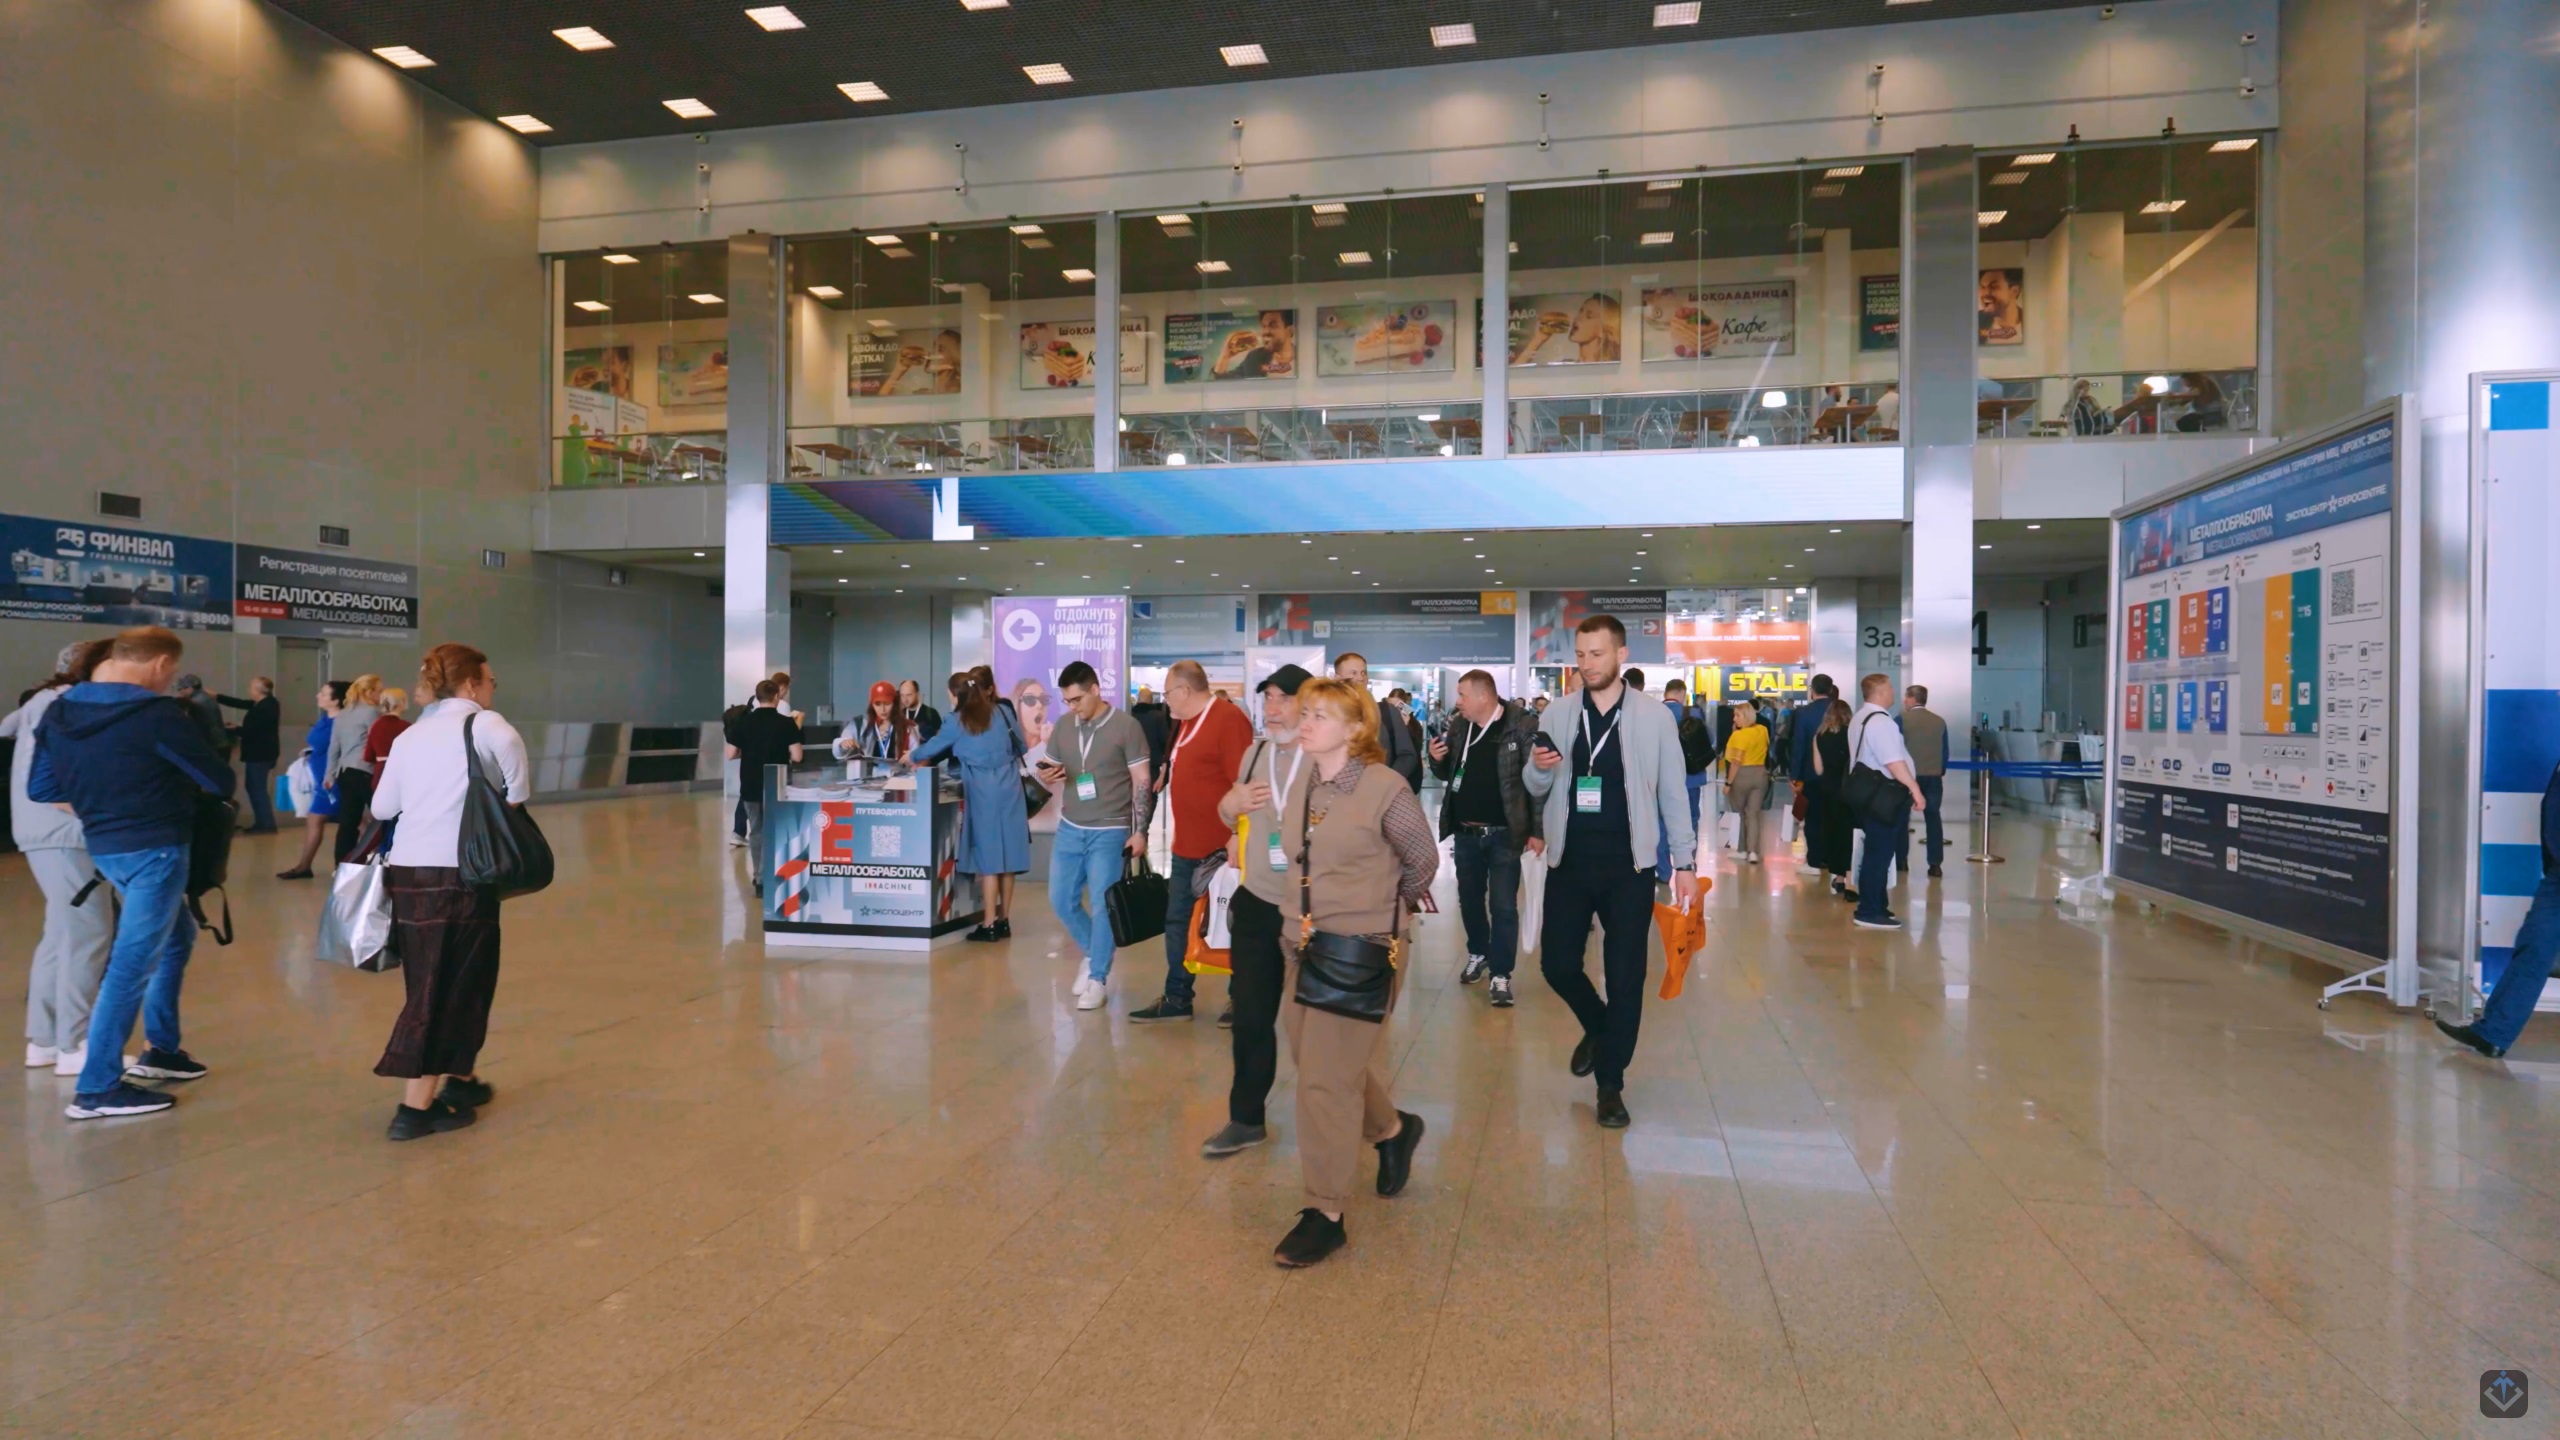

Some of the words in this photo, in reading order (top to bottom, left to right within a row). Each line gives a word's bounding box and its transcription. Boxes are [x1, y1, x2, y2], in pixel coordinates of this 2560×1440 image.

[1688, 289, 1788, 302] ШОКОЛАДНИЦА
[1721, 314, 1767, 342] Кафе
[851, 354, 885, 365] ДЕТКА!
[2337, 484, 2387, 508] EXPOCENTRE
[2190, 504, 2273, 542] МЕТАЛЛООБРАБОТКА
[90, 531, 174, 558] ФИНВАЛ
[2314, 542, 2321, 561] 3
[260, 556, 336, 576] Регистрация
[339, 567, 407, 583] посетителей
[2224, 564, 2230, 581] 2
[0, 600, 44, 609] АВИГАТОР
[244, 583, 408, 612] МЕТАЛЛООБРАБОТКА
[0, 609, 82, 621] РОМЫШЛЕННОСТИ
[1054, 608, 1117, 622] ОТДОХНУТЬ
[1048, 623, 1056, 636] И
[1059, 623, 1117, 636] ПОЛУЧИТЬ
[1863, 626, 1902, 648] За
[1972, 610, 1994, 666] 4
[855, 807, 917, 816] ПУТЕВОДИТЕЛЬ
[812, 864, 926, 878] МЕТАЛЛООБРАБОТКА
[872, 908, 924, 916] ЭКСПОЦЕНТР
